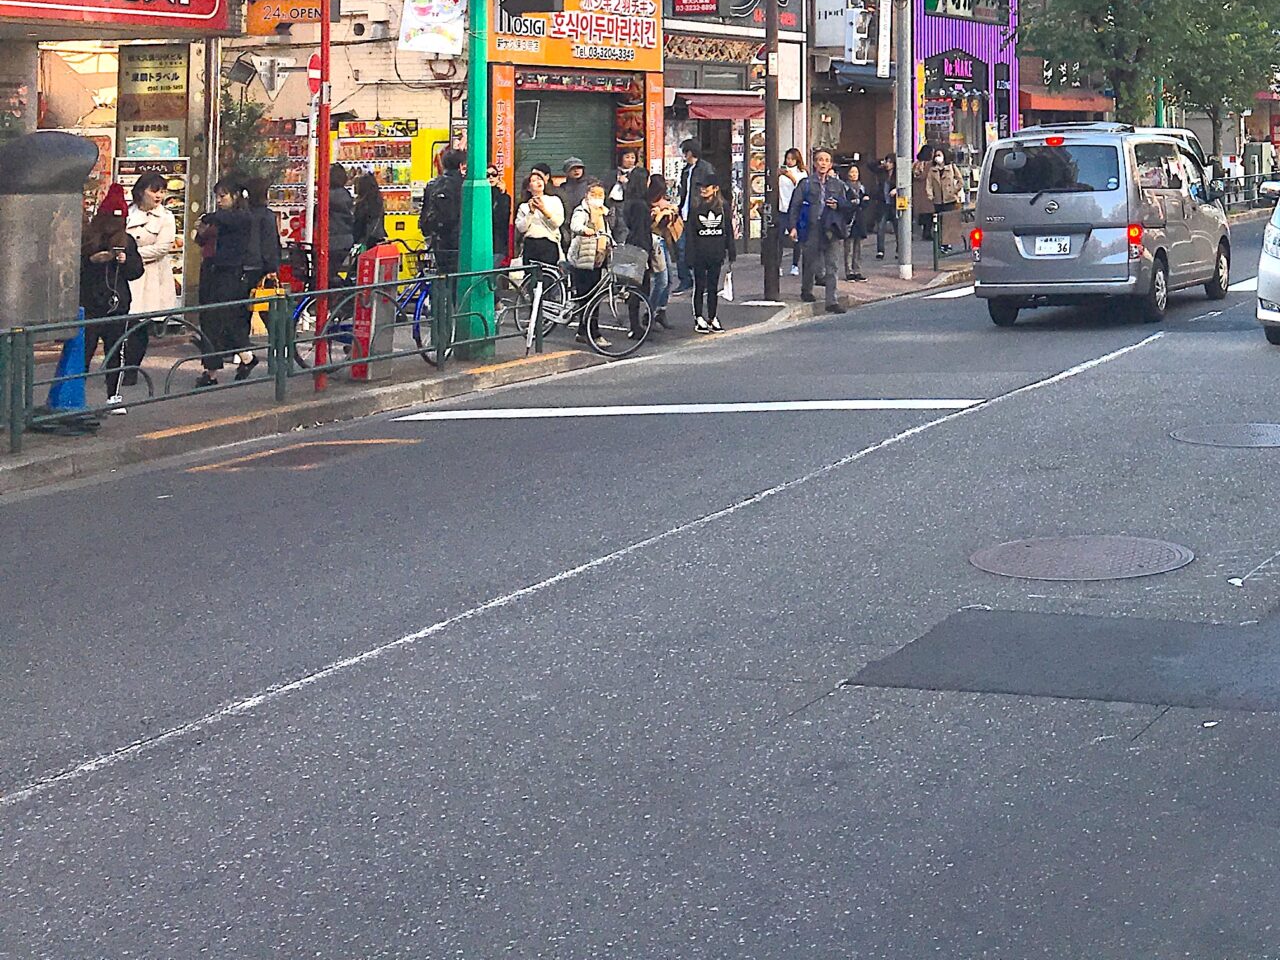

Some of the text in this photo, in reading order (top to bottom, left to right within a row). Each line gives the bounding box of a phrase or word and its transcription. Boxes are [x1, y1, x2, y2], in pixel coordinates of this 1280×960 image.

[552, 13, 657, 45] 호식이두마리치킨
[698, 228, 722, 236] adidas
[1057, 242, 1068, 253] 36
